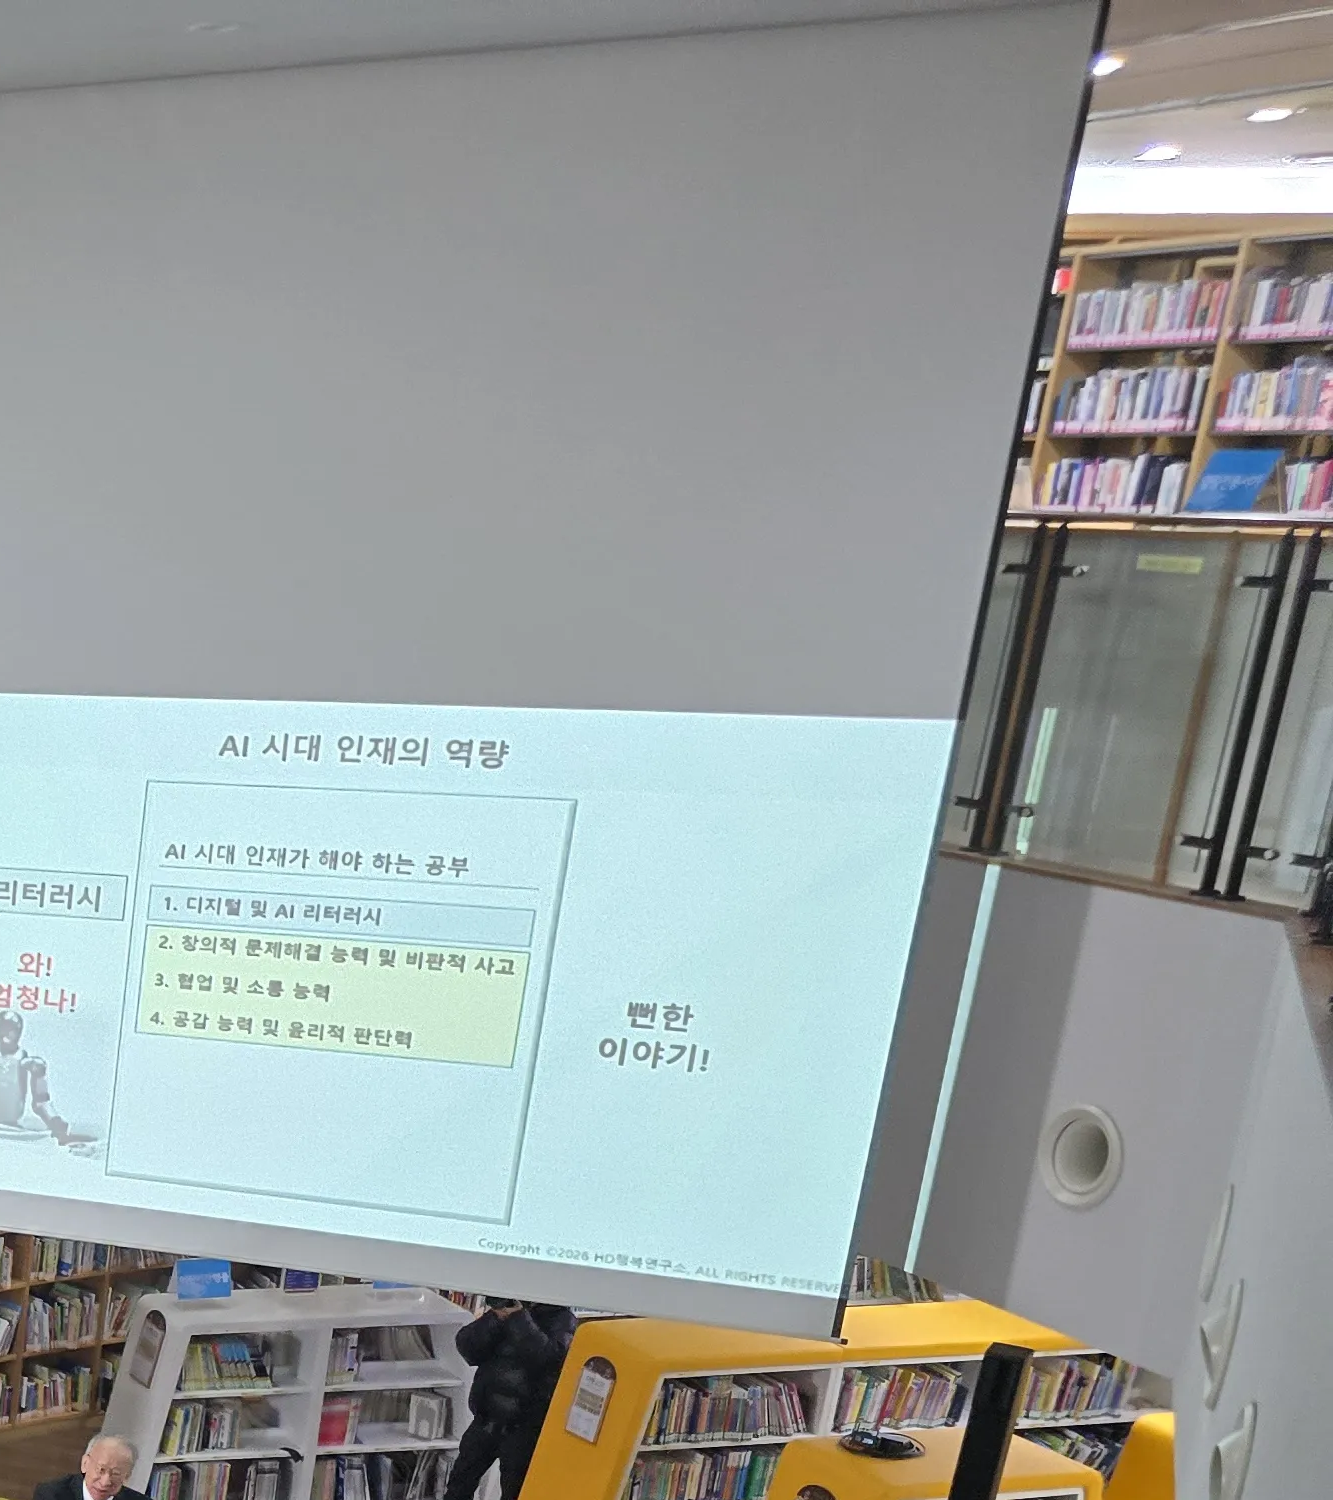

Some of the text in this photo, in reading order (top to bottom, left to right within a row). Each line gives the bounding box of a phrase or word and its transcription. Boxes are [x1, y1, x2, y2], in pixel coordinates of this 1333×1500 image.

[219, 733, 510, 770] AI 시대 인재의 역량
[165, 843, 469, 878] AI 시대 인재가 해야 하는 공부
[164, 896, 382, 926] 1. 디지털 및 AI 리터러시
[17, 952, 53, 978] 와!
[158, 935, 515, 977] 2. 창의적 문제해결 능력 및 비판적 사고
[154, 973, 169, 988] 3.
[222, 975, 239, 995] 및
[293, 982, 330, 1002] 능력
[150, 1011, 165, 1026] 4.
[173, 1010, 209, 1030] 공감
[217, 1014, 253, 1035] 능력
[262, 1017, 279, 1037] 및
[354, 1026, 413, 1049] 판단력
[626, 1001, 694, 1033] 뻔한
[598, 1037, 710, 1073] 이야기!
[478, 1237, 541, 1257] Copyright
[696, 1265, 720, 1279] ALL
[724, 1268, 777, 1286] RIGHTS
